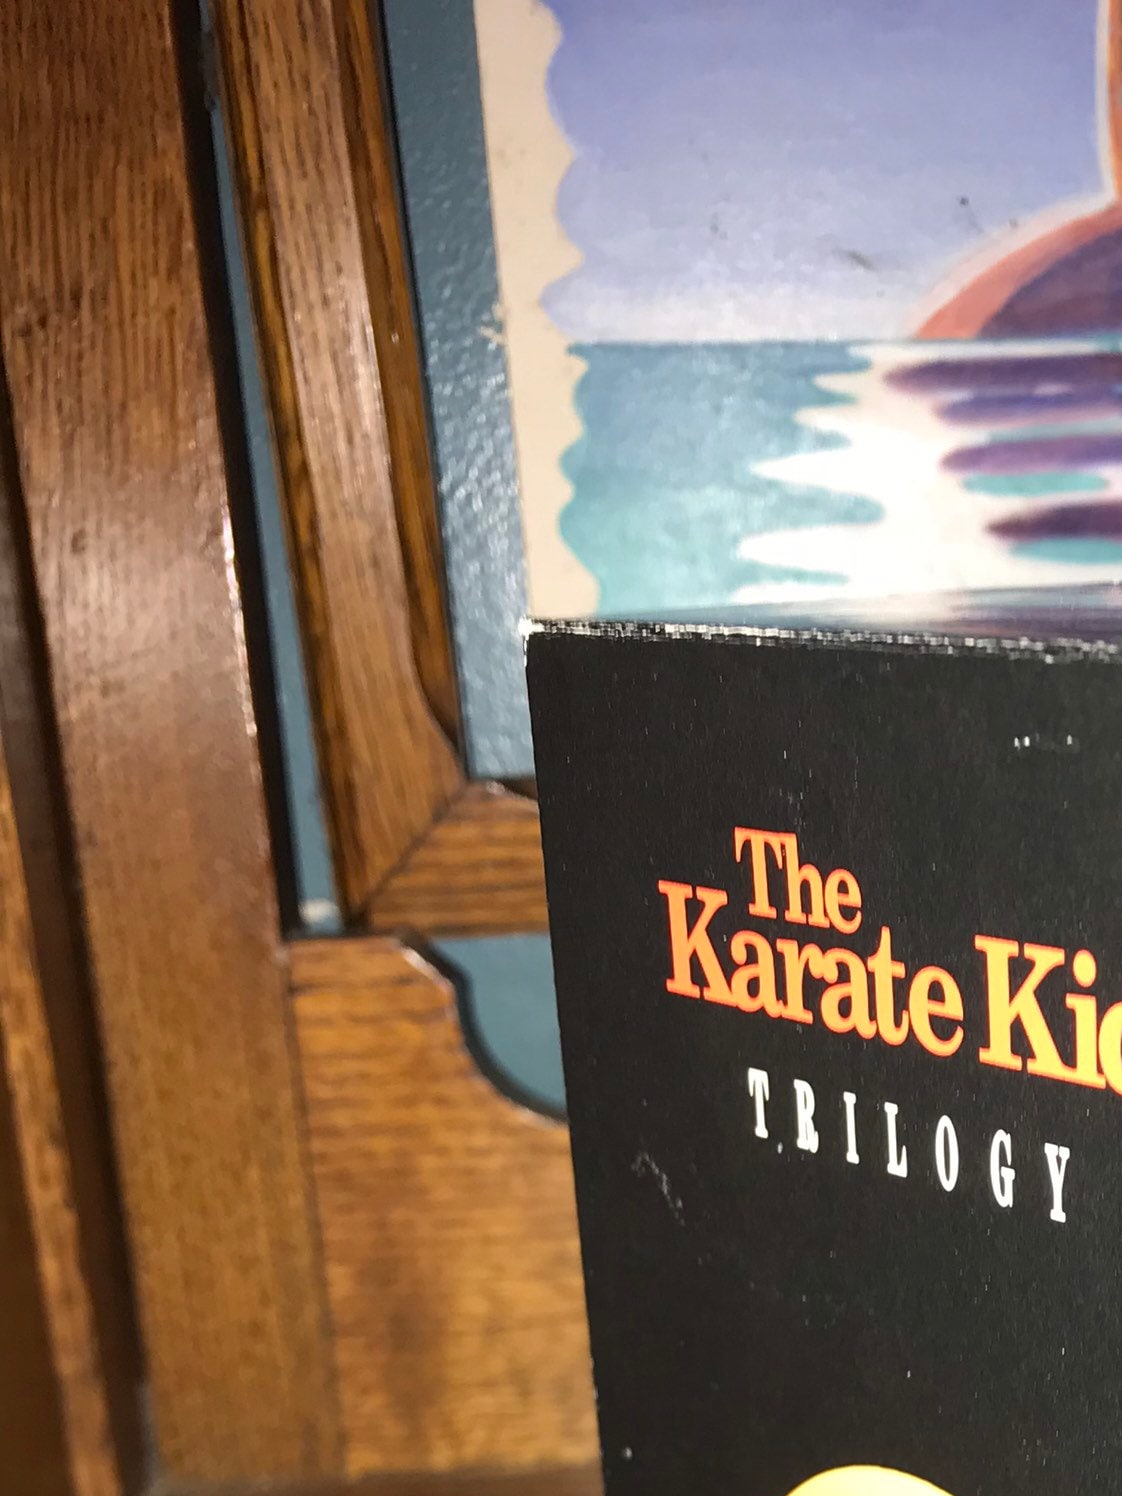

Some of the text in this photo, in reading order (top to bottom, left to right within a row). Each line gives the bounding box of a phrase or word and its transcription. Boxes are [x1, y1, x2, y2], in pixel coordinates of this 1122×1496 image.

[735, 826, 862, 935] The
[658, 879, 964, 1057] Karate
[748, 1067, 1070, 1223] TRILOGY
